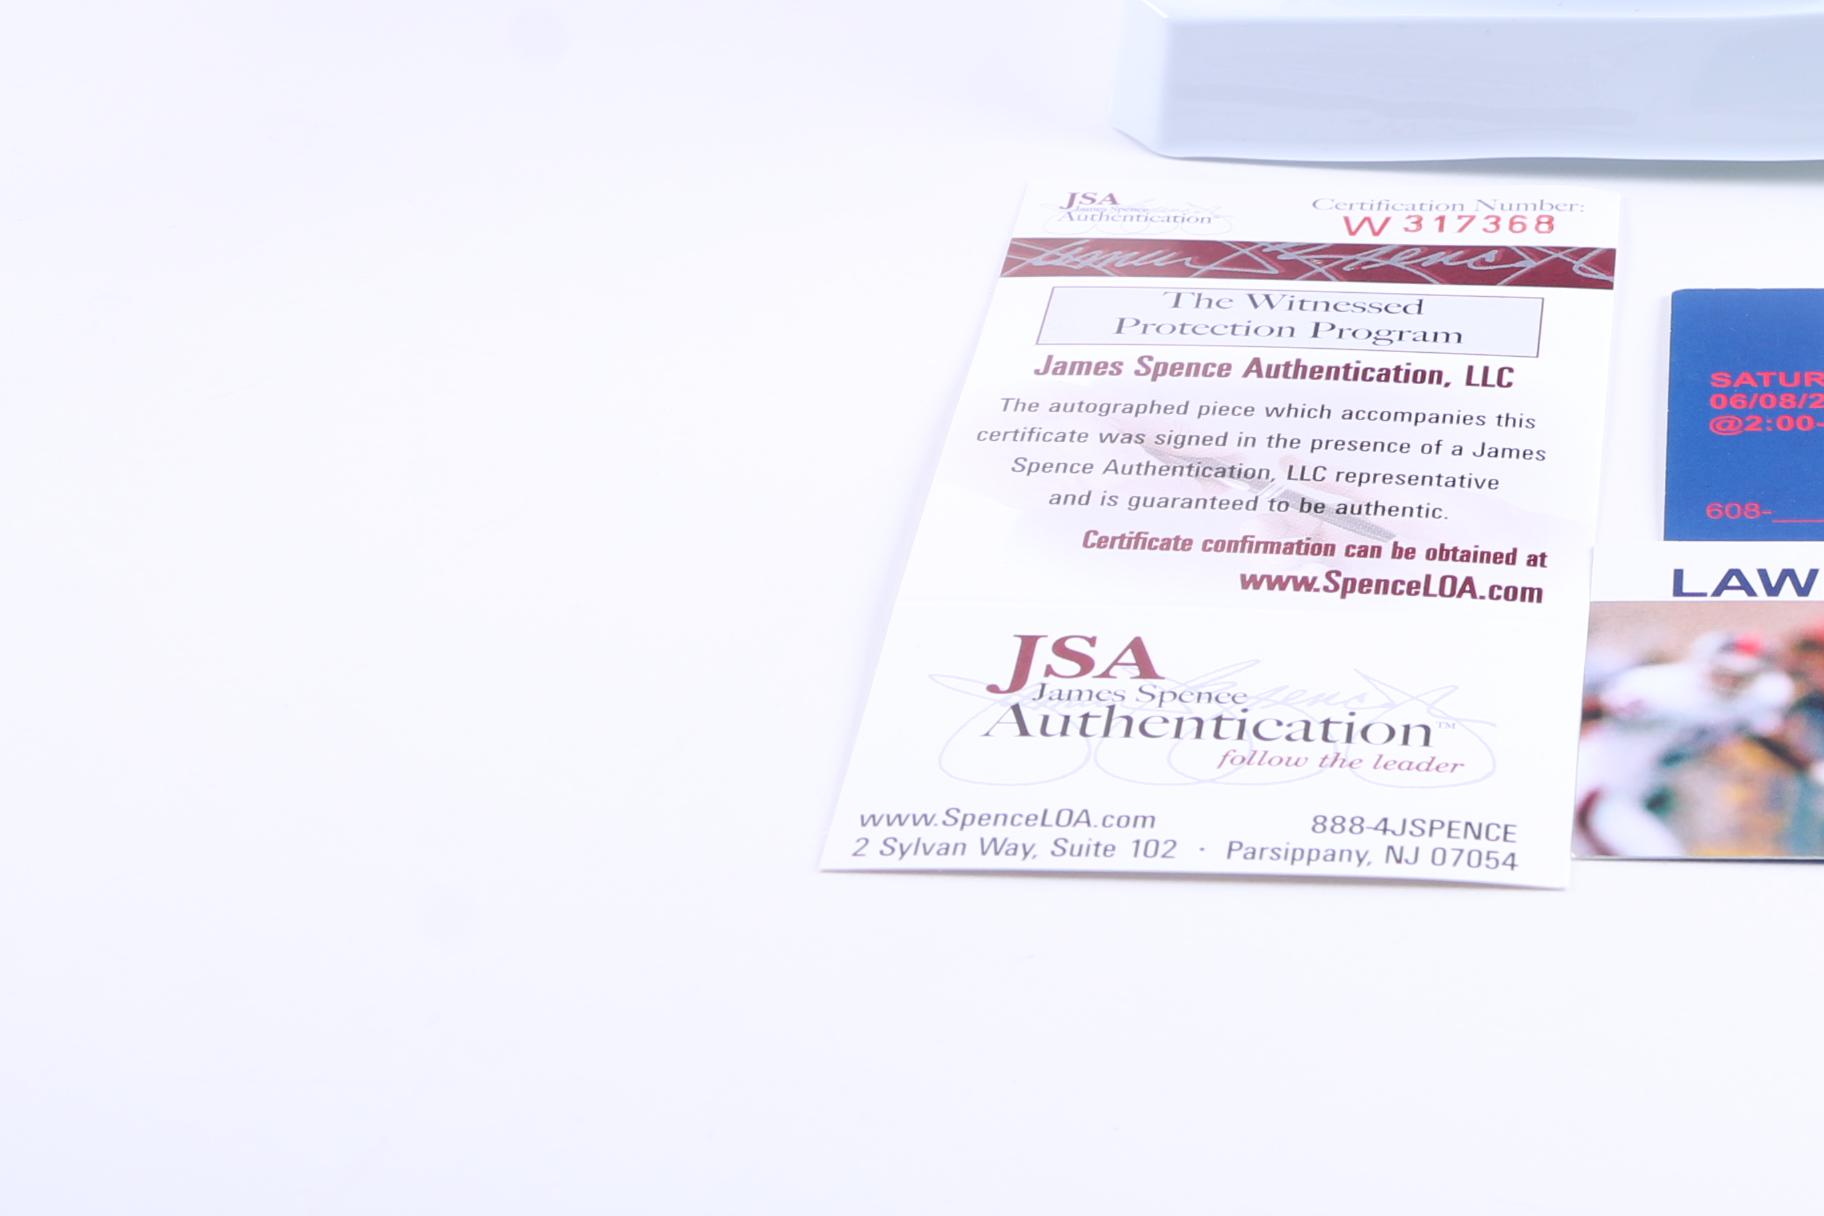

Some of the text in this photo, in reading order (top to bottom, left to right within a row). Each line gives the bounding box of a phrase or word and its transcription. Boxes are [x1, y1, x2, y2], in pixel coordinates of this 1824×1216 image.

[1059, 191, 1119, 210] JSA
[1311, 198, 1585, 214] Certification Number:
[1057, 209, 1212, 224] Authentication
[1342, 214, 1555, 237] W 317368
[1163, 291, 1427, 316] The Witnessed
[1115, 317, 1463, 346] Protection Program
[1033, 354, 1515, 389] James Spence Authentication, LLC
[1001, 397, 1536, 429] The autographed piece which accompanies this
[976, 426, 1546, 462] certificate was signed in the presence of a James
[1010, 456, 1500, 490] Spence Authentication, LLC representative
[1048, 489, 1448, 520] and is guaranteed to be authentic.
[1082, 529, 1548, 569] Certificate confirmation can be obtained at
[1239, 569, 1544, 604] www.SpenceLOA.com
[985, 634, 1166, 697] JSA
[1031, 682, 1249, 712] James Spence
[1216, 748, 1465, 774] follow the leader
[860, 807, 1156, 832] www.SpenceLOA.com
[1311, 814, 1517, 844] 888-4JSPENCE
[851, 836, 1519, 872] 2 Sylvan Way, Suite 102 Parsippany, NJ 07054
